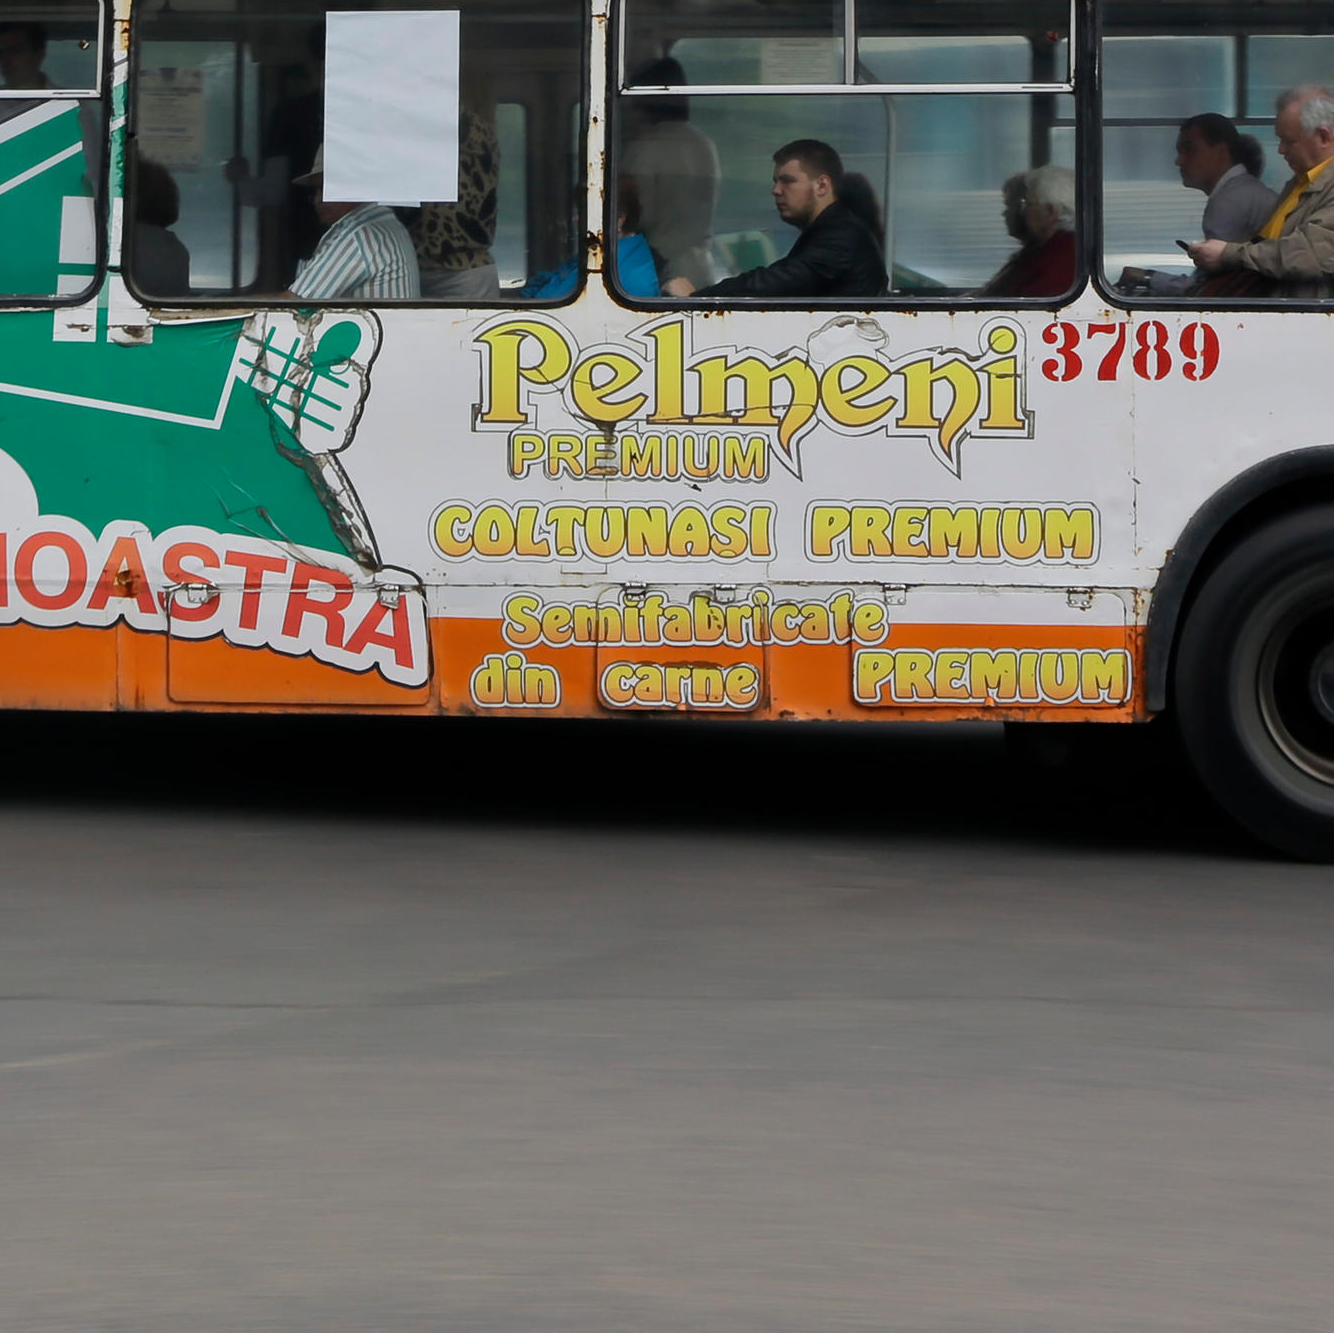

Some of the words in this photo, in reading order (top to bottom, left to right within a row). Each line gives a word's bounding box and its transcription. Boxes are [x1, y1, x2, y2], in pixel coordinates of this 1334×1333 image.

[1042, 320, 1220, 382] 3789
[472, 320, 1026, 467] Pelmeni
[512, 434, 766, 478] PREMIUM
[812, 506, 1094, 559] PREMIUM
[505, 589, 886, 644] Semifabricate
[474, 654, 557, 703] din
[605, 665, 757, 705] carne
[857, 650, 1127, 704] PREMIUM
